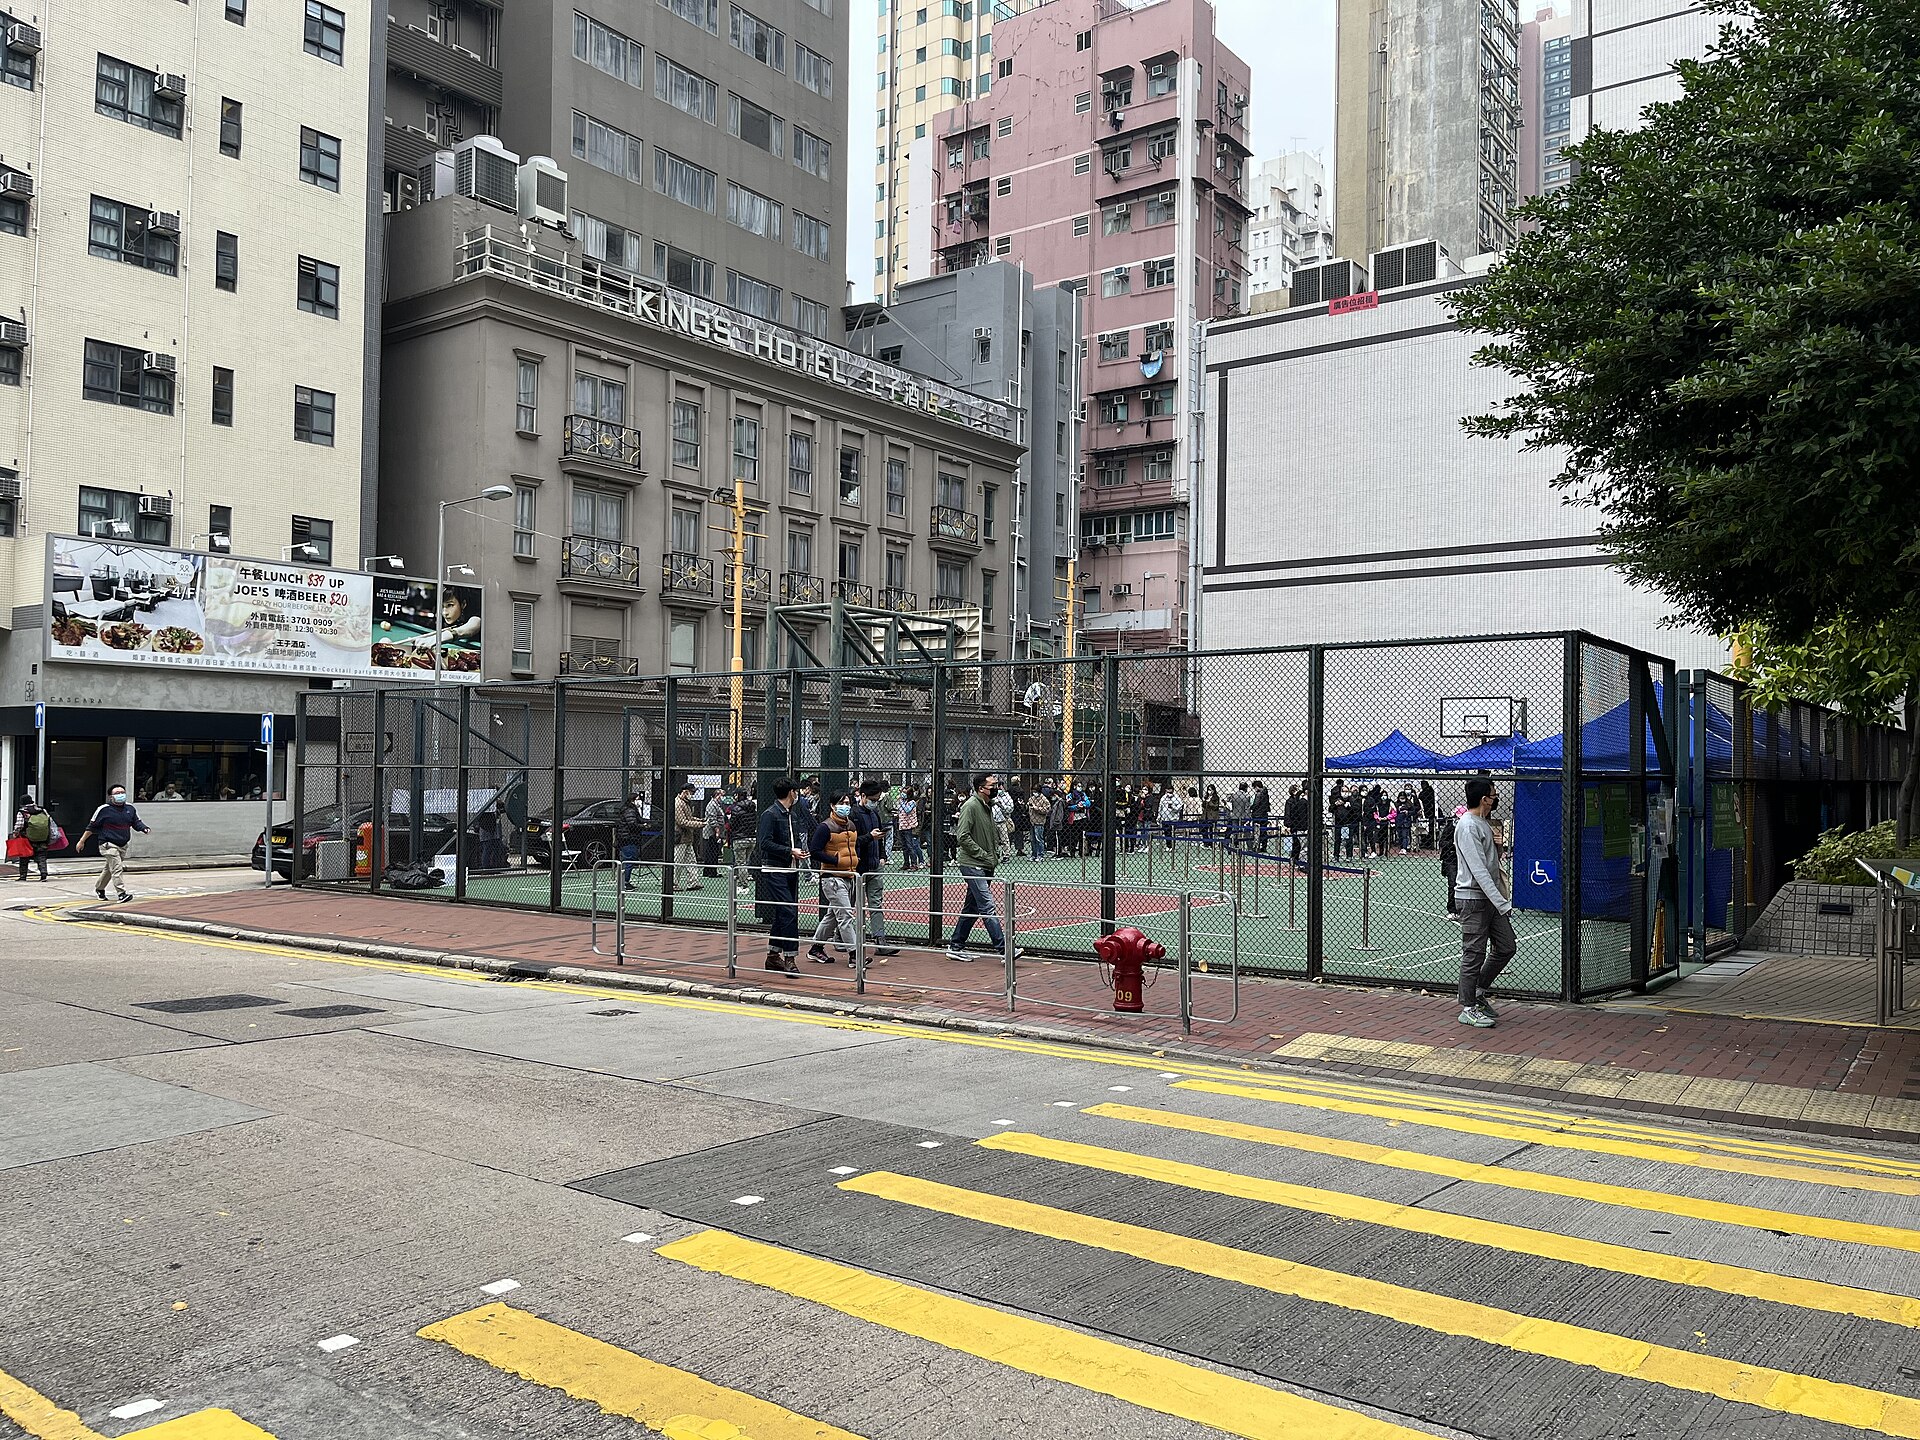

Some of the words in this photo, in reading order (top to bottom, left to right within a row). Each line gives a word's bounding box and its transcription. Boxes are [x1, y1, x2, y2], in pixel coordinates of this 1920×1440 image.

[1333, 295, 1373, 310] 廣告位招租
[635, 287, 732, 347] KINGS
[754, 329, 848, 385] HOTEL
[866, 367, 939, 415] 王子酒店
[307, 573, 326, 587] $39
[329, 579, 345, 589] UP
[172, 586, 196, 601] 4/F
[233, 585, 270, 598] JOE'S
[329, 592, 349, 607] $20
[383, 603, 402, 617] 1/F
[291, 616, 311, 625] 3701
[313, 618, 333, 627] 0909
[295, 625, 314, 633] 12:30
[319, 627, 338, 635] 20:30
[276, 639, 306, 649] 王子酒店
[50, 696, 103, 704] CASCARA
[1117, 990, 1133, 1002] 09
